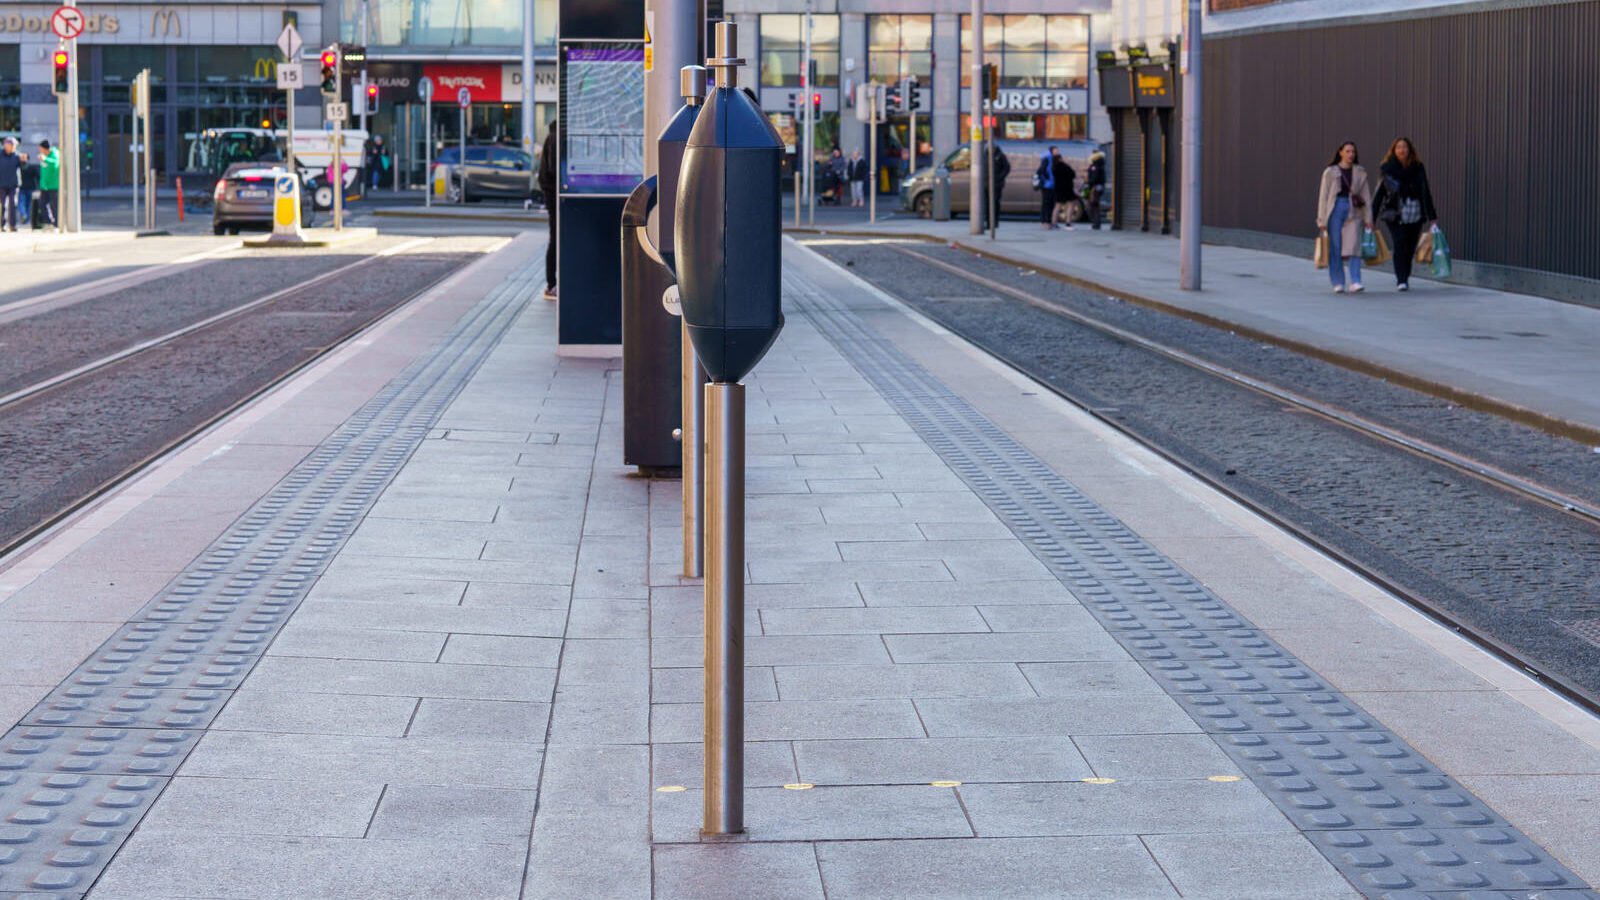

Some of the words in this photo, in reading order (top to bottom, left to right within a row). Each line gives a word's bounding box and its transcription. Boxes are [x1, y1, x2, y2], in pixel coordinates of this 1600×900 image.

[282, 70, 297, 82] 15
[511, 71, 557, 85] DNN
[331, 106, 344, 117] 15
